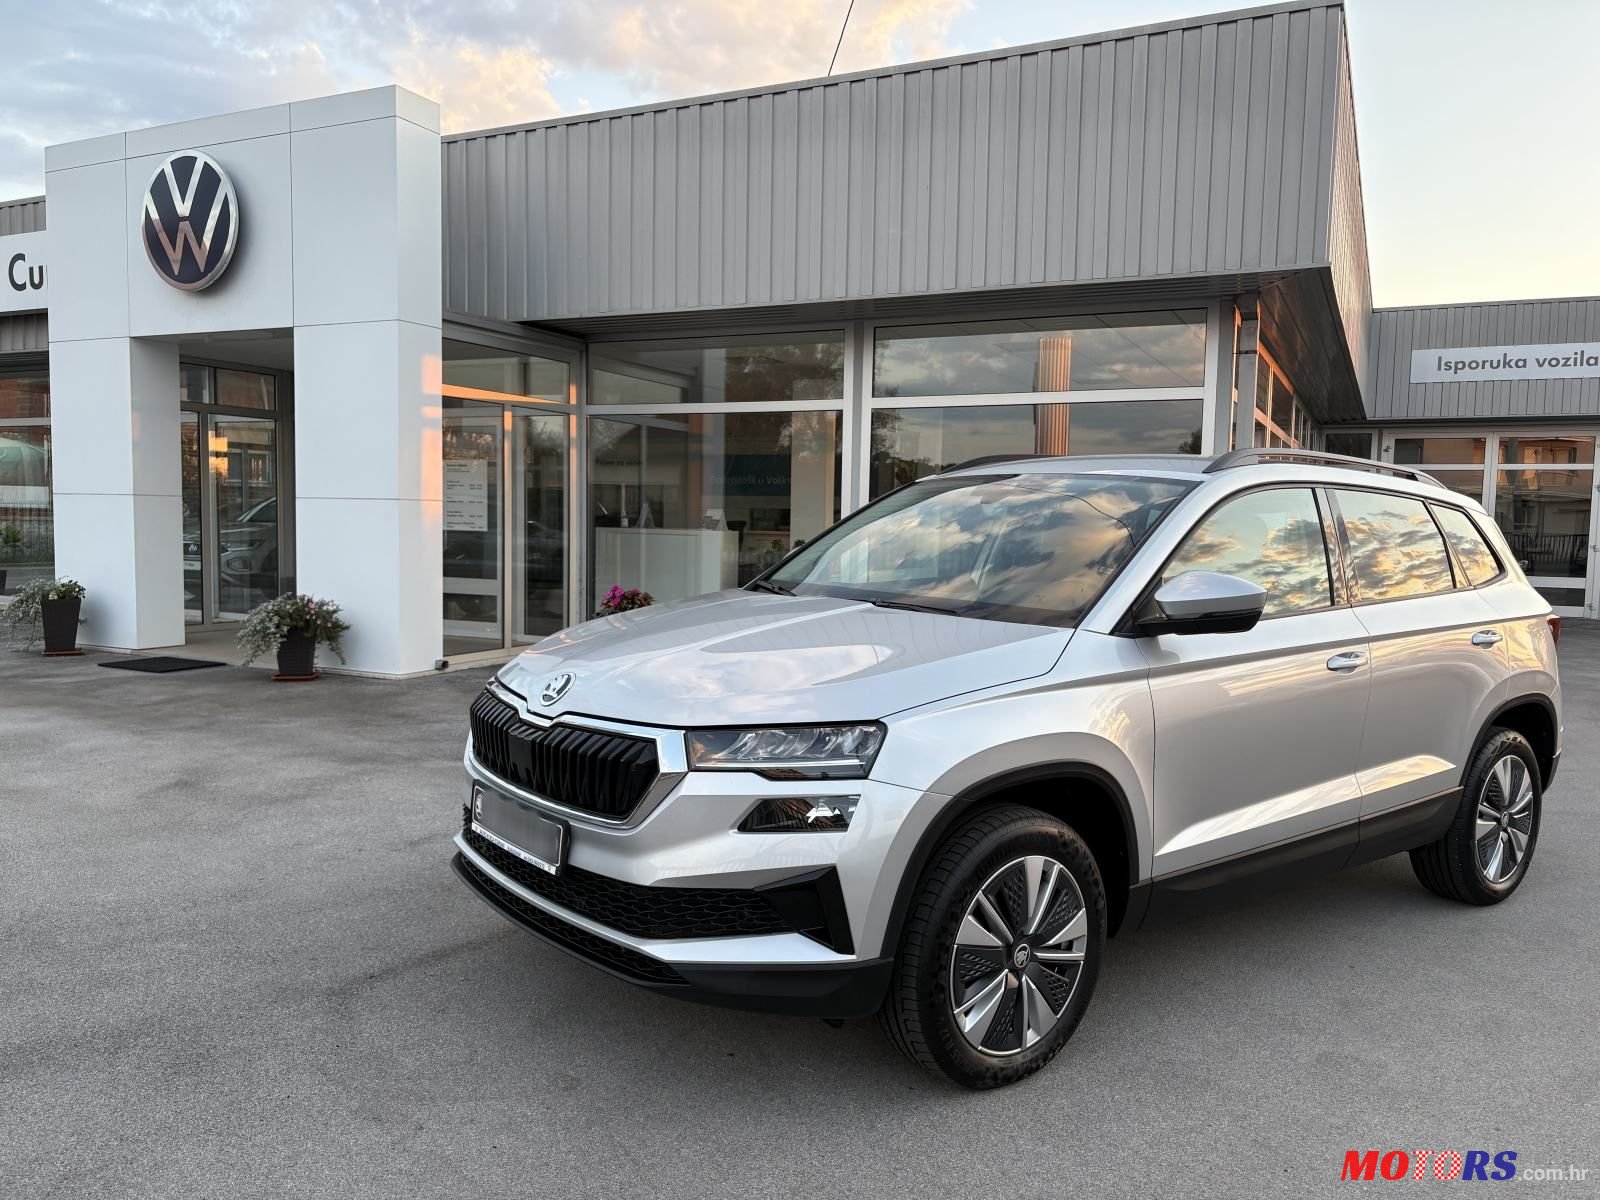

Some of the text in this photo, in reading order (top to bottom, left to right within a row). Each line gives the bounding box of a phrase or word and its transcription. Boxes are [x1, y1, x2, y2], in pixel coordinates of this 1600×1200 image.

[8, 252, 49, 292] Cu
[1437, 349, 1600, 375] Isporuka vozila
